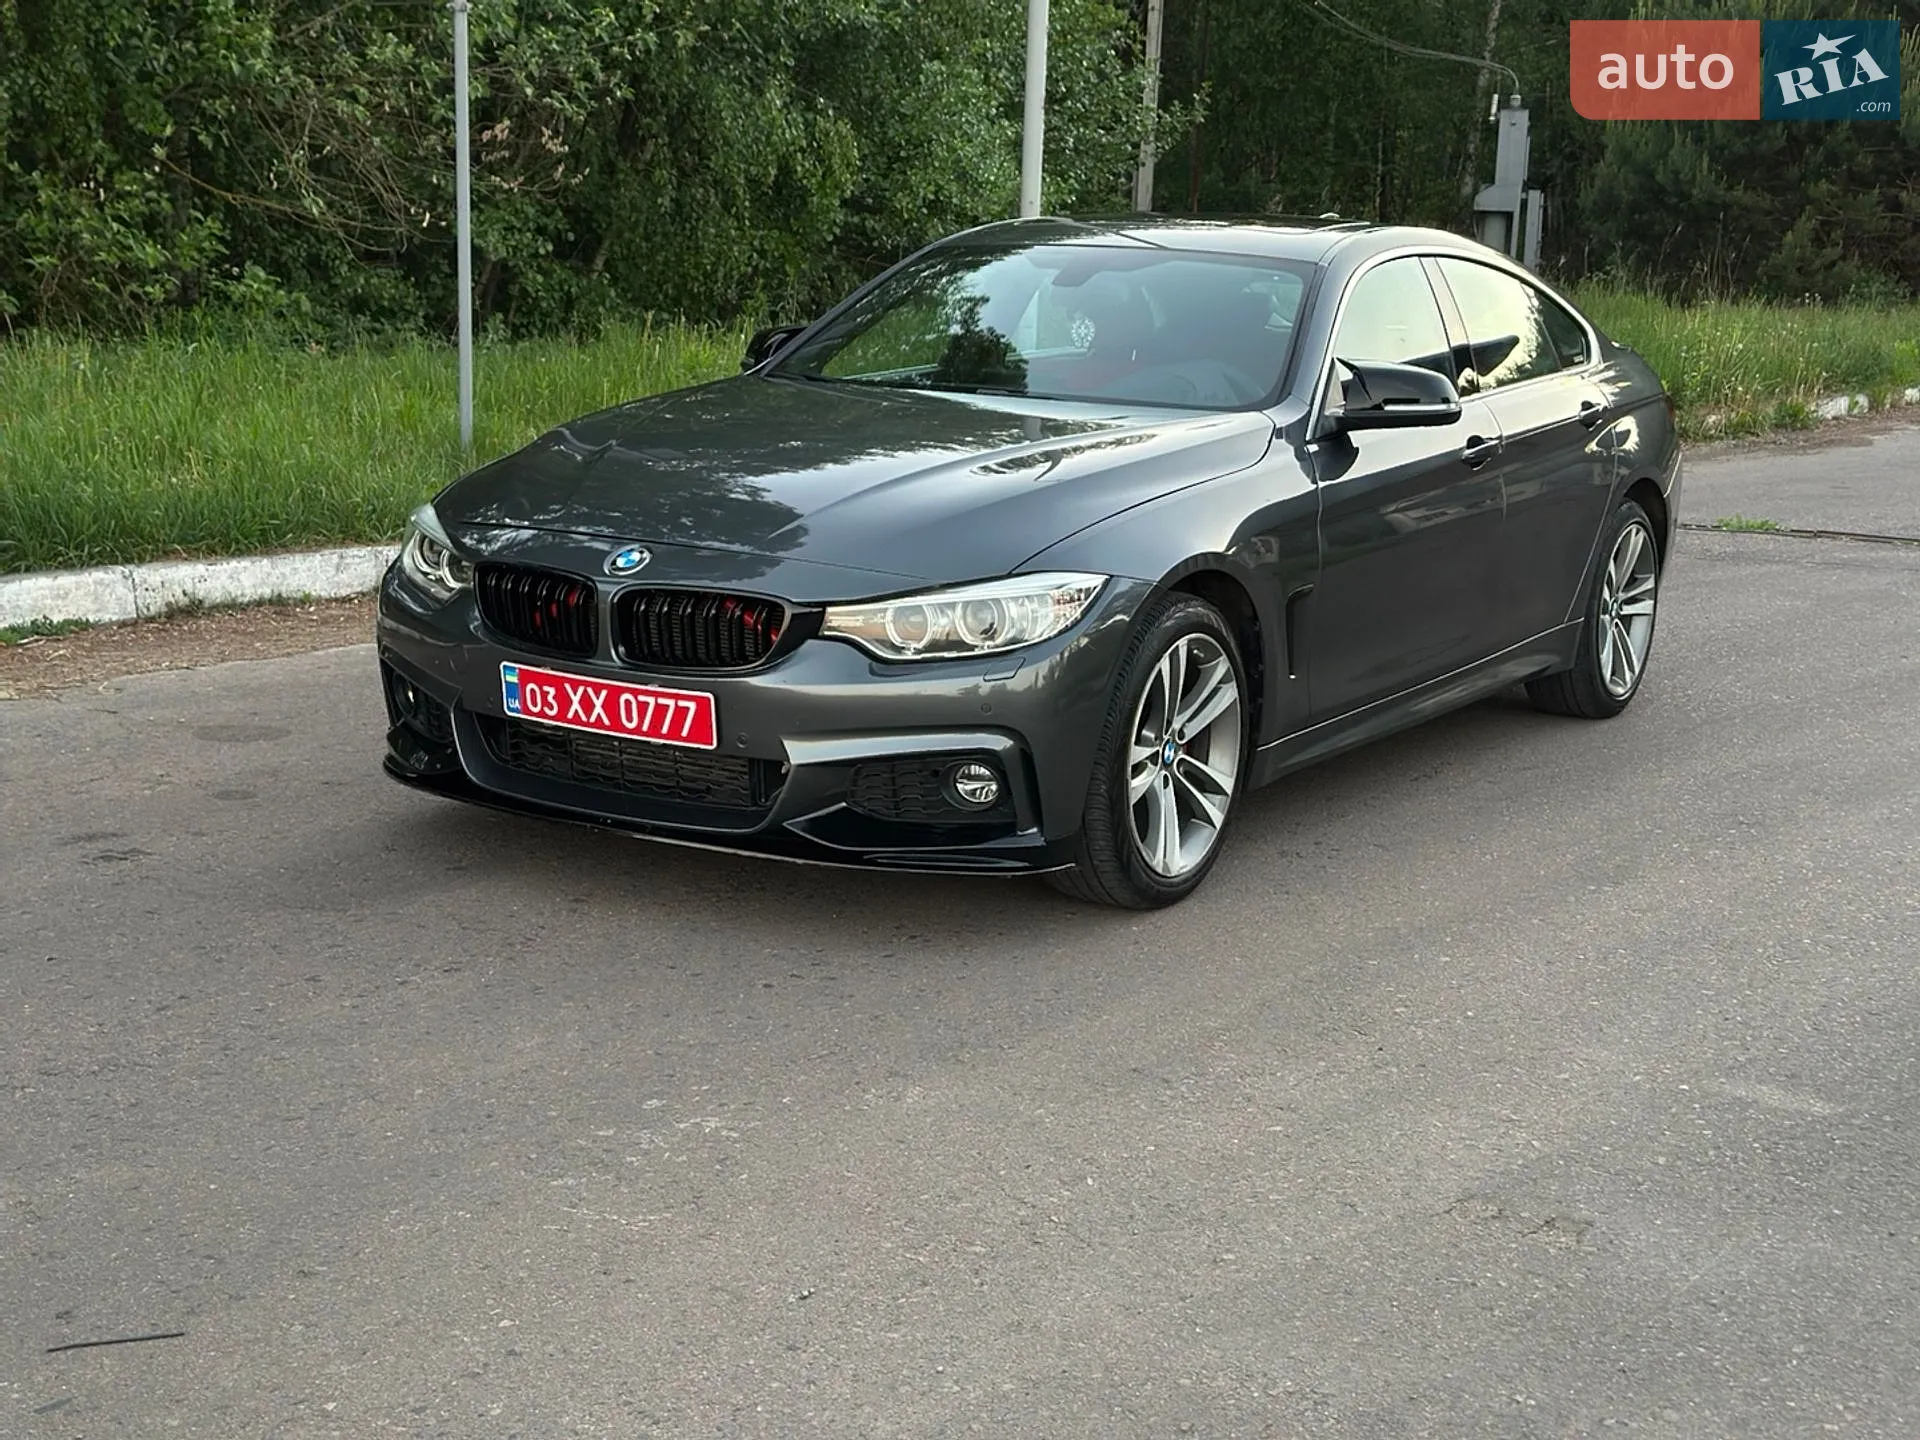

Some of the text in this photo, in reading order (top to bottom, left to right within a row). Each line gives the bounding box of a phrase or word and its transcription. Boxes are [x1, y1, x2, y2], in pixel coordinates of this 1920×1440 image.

[508, 700, 521, 710] UA
[525, 682, 697, 738] 03 XX 0777
